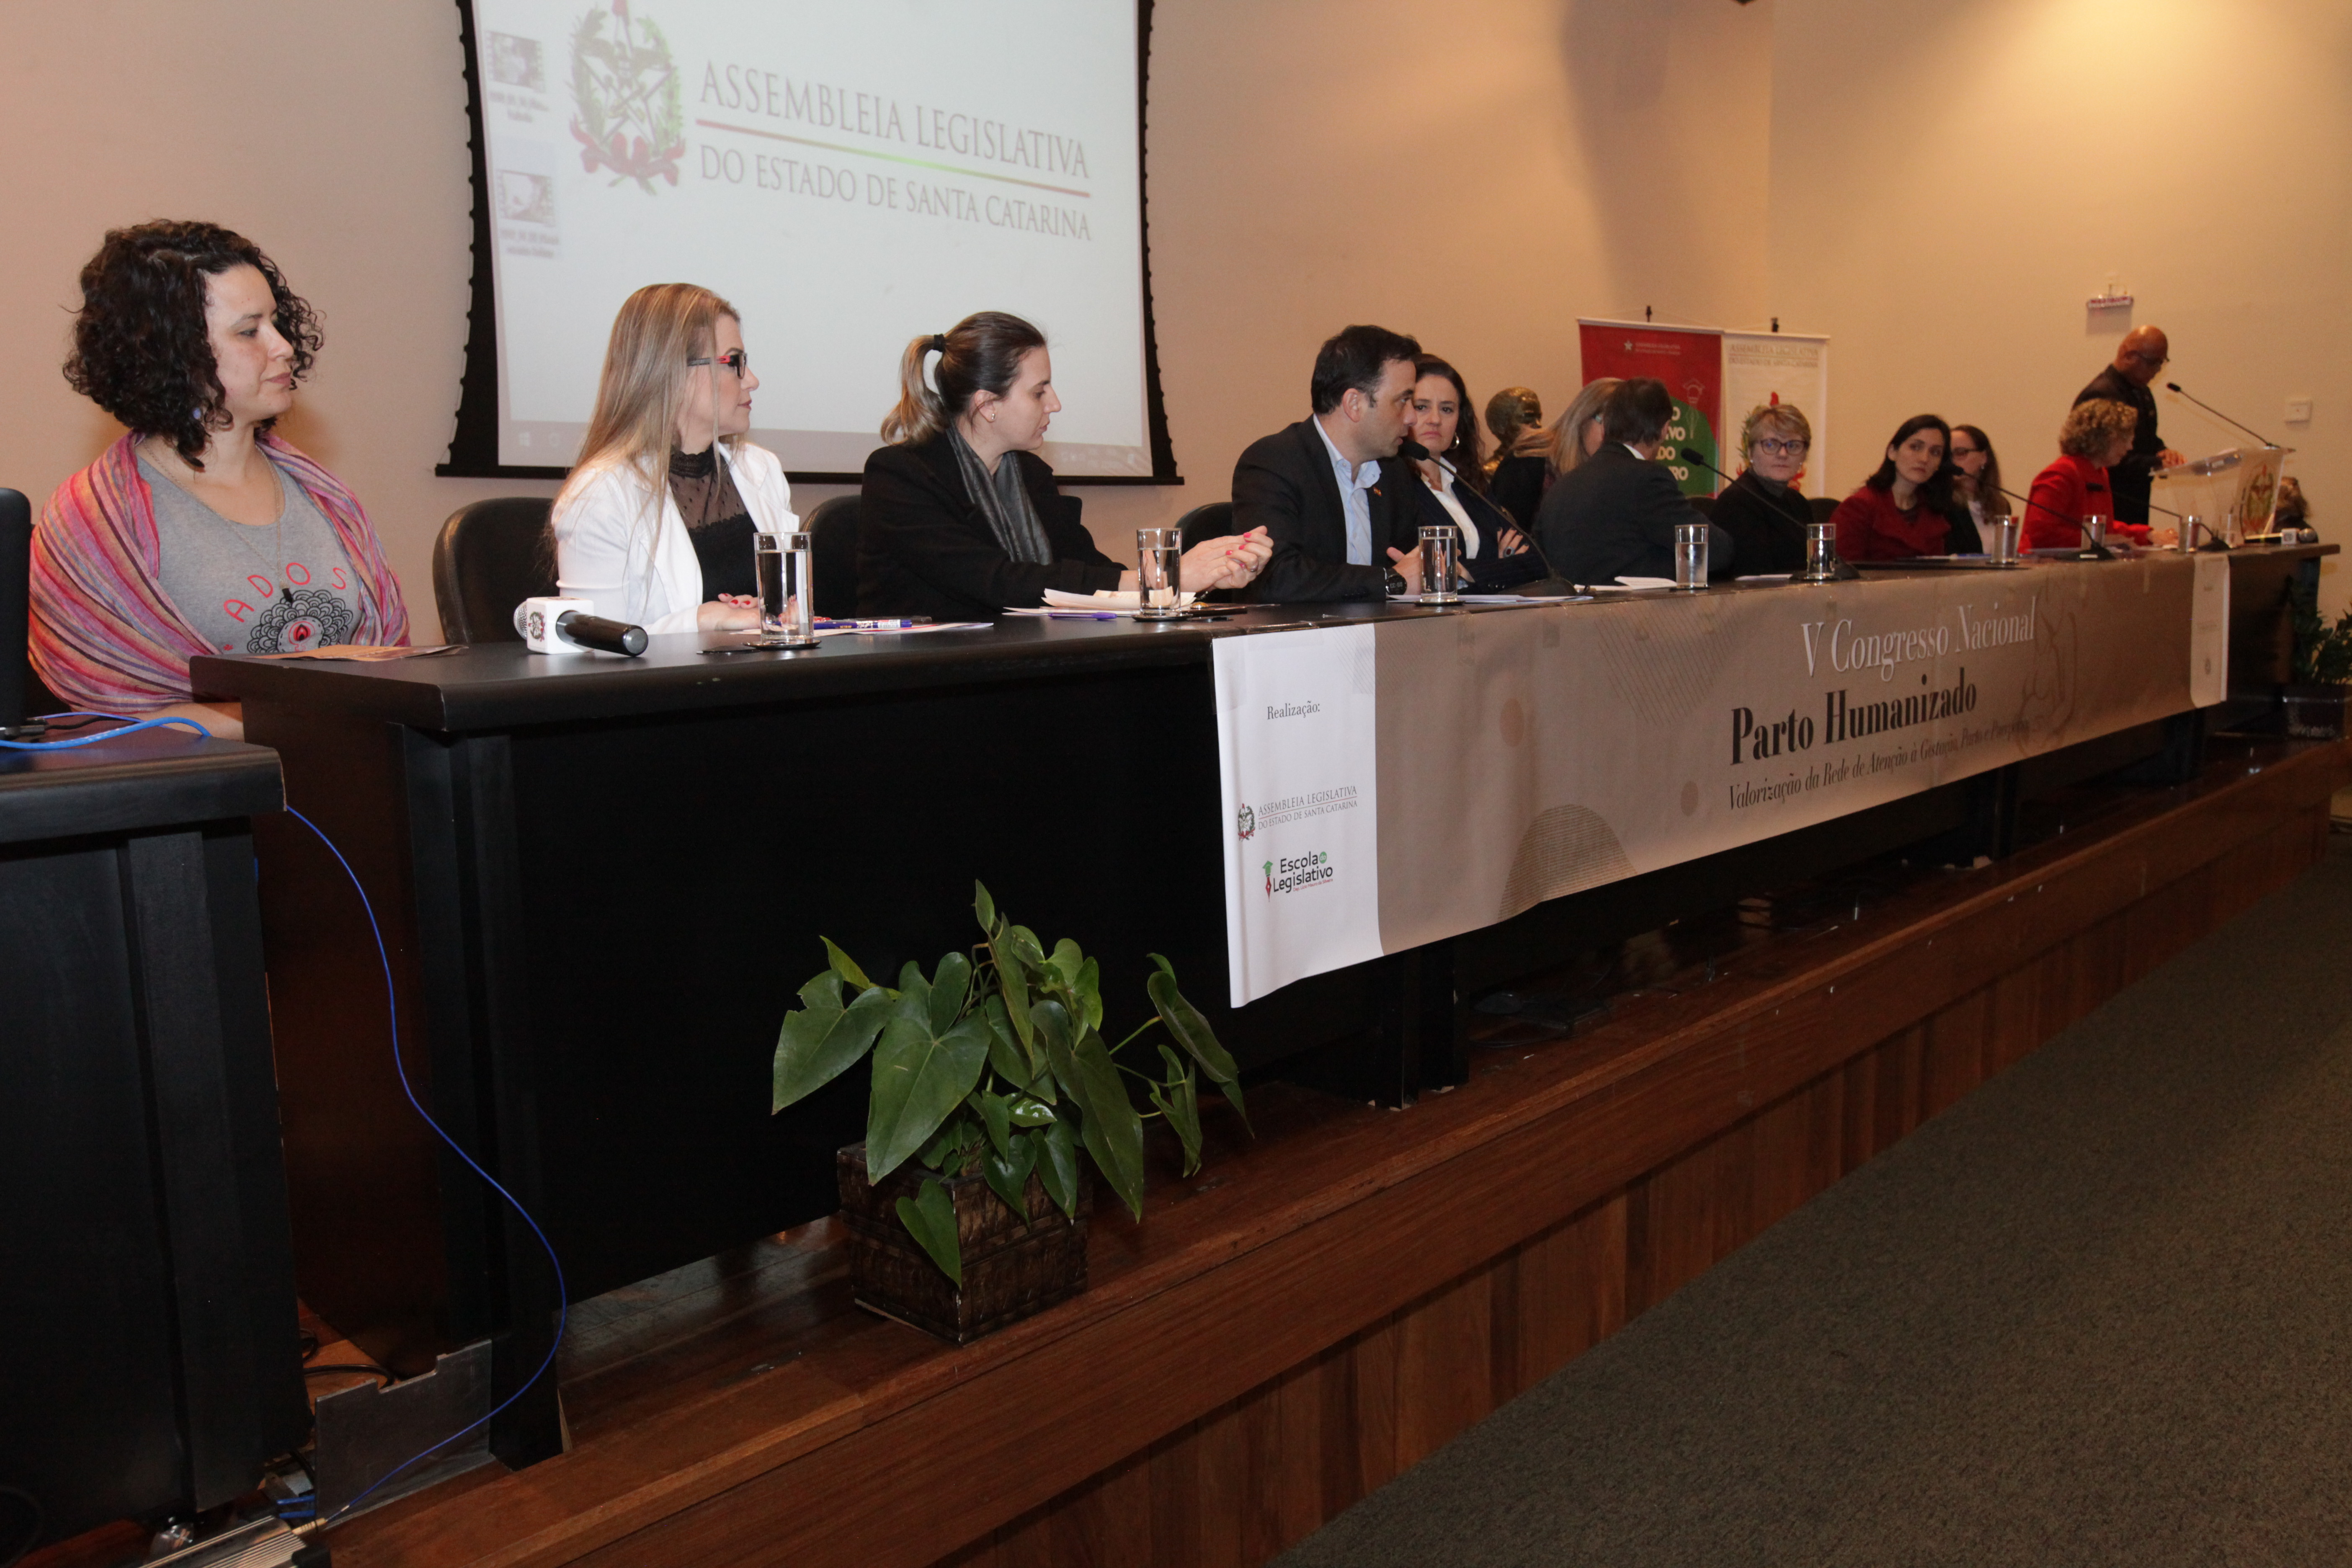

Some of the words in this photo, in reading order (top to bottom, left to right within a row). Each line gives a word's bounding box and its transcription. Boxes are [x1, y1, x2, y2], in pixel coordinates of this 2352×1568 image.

[699, 59, 906, 142] ASSEMBLEIA
[916, 105, 1089, 179] LEGISLATIVA
[700, 144, 744, 184] DO
[755, 153, 856, 202] ESTADO
[867, 173, 897, 209] DE
[906, 181, 980, 223] SANTA
[985, 195, 1092, 241] CATARINA
[1801, 622, 1824, 677] V
[1831, 619, 1949, 682] Congresso
[1955, 596, 2036, 653] Nacional
[1267, 700, 1320, 720] Realização:
[1730, 707, 1814, 766] Parto
[1824, 667, 1977, 745] Humanizado
[1258, 796, 1305, 816] ASSEMBLEIA
[1307, 786, 1357, 804] LEGISLATIVA
[1730, 773, 1801, 810] Valorização
[1805, 766, 1819, 791] da
[1823, 758, 1849, 787] Rede
[1852, 755, 1865, 778] de
[1867, 746, 1908, 774] Atenção
[1259, 820, 1268, 830] DO
[1269, 814, 1292, 827] ESTADO
[1294, 811, 1302, 820] DE
[1304, 807, 1324, 818] SANTA
[1326, 800, 1358, 813] CATARINA
[1274, 866, 1333, 893] Legislativo
[1280, 851, 1318, 874] Escola
